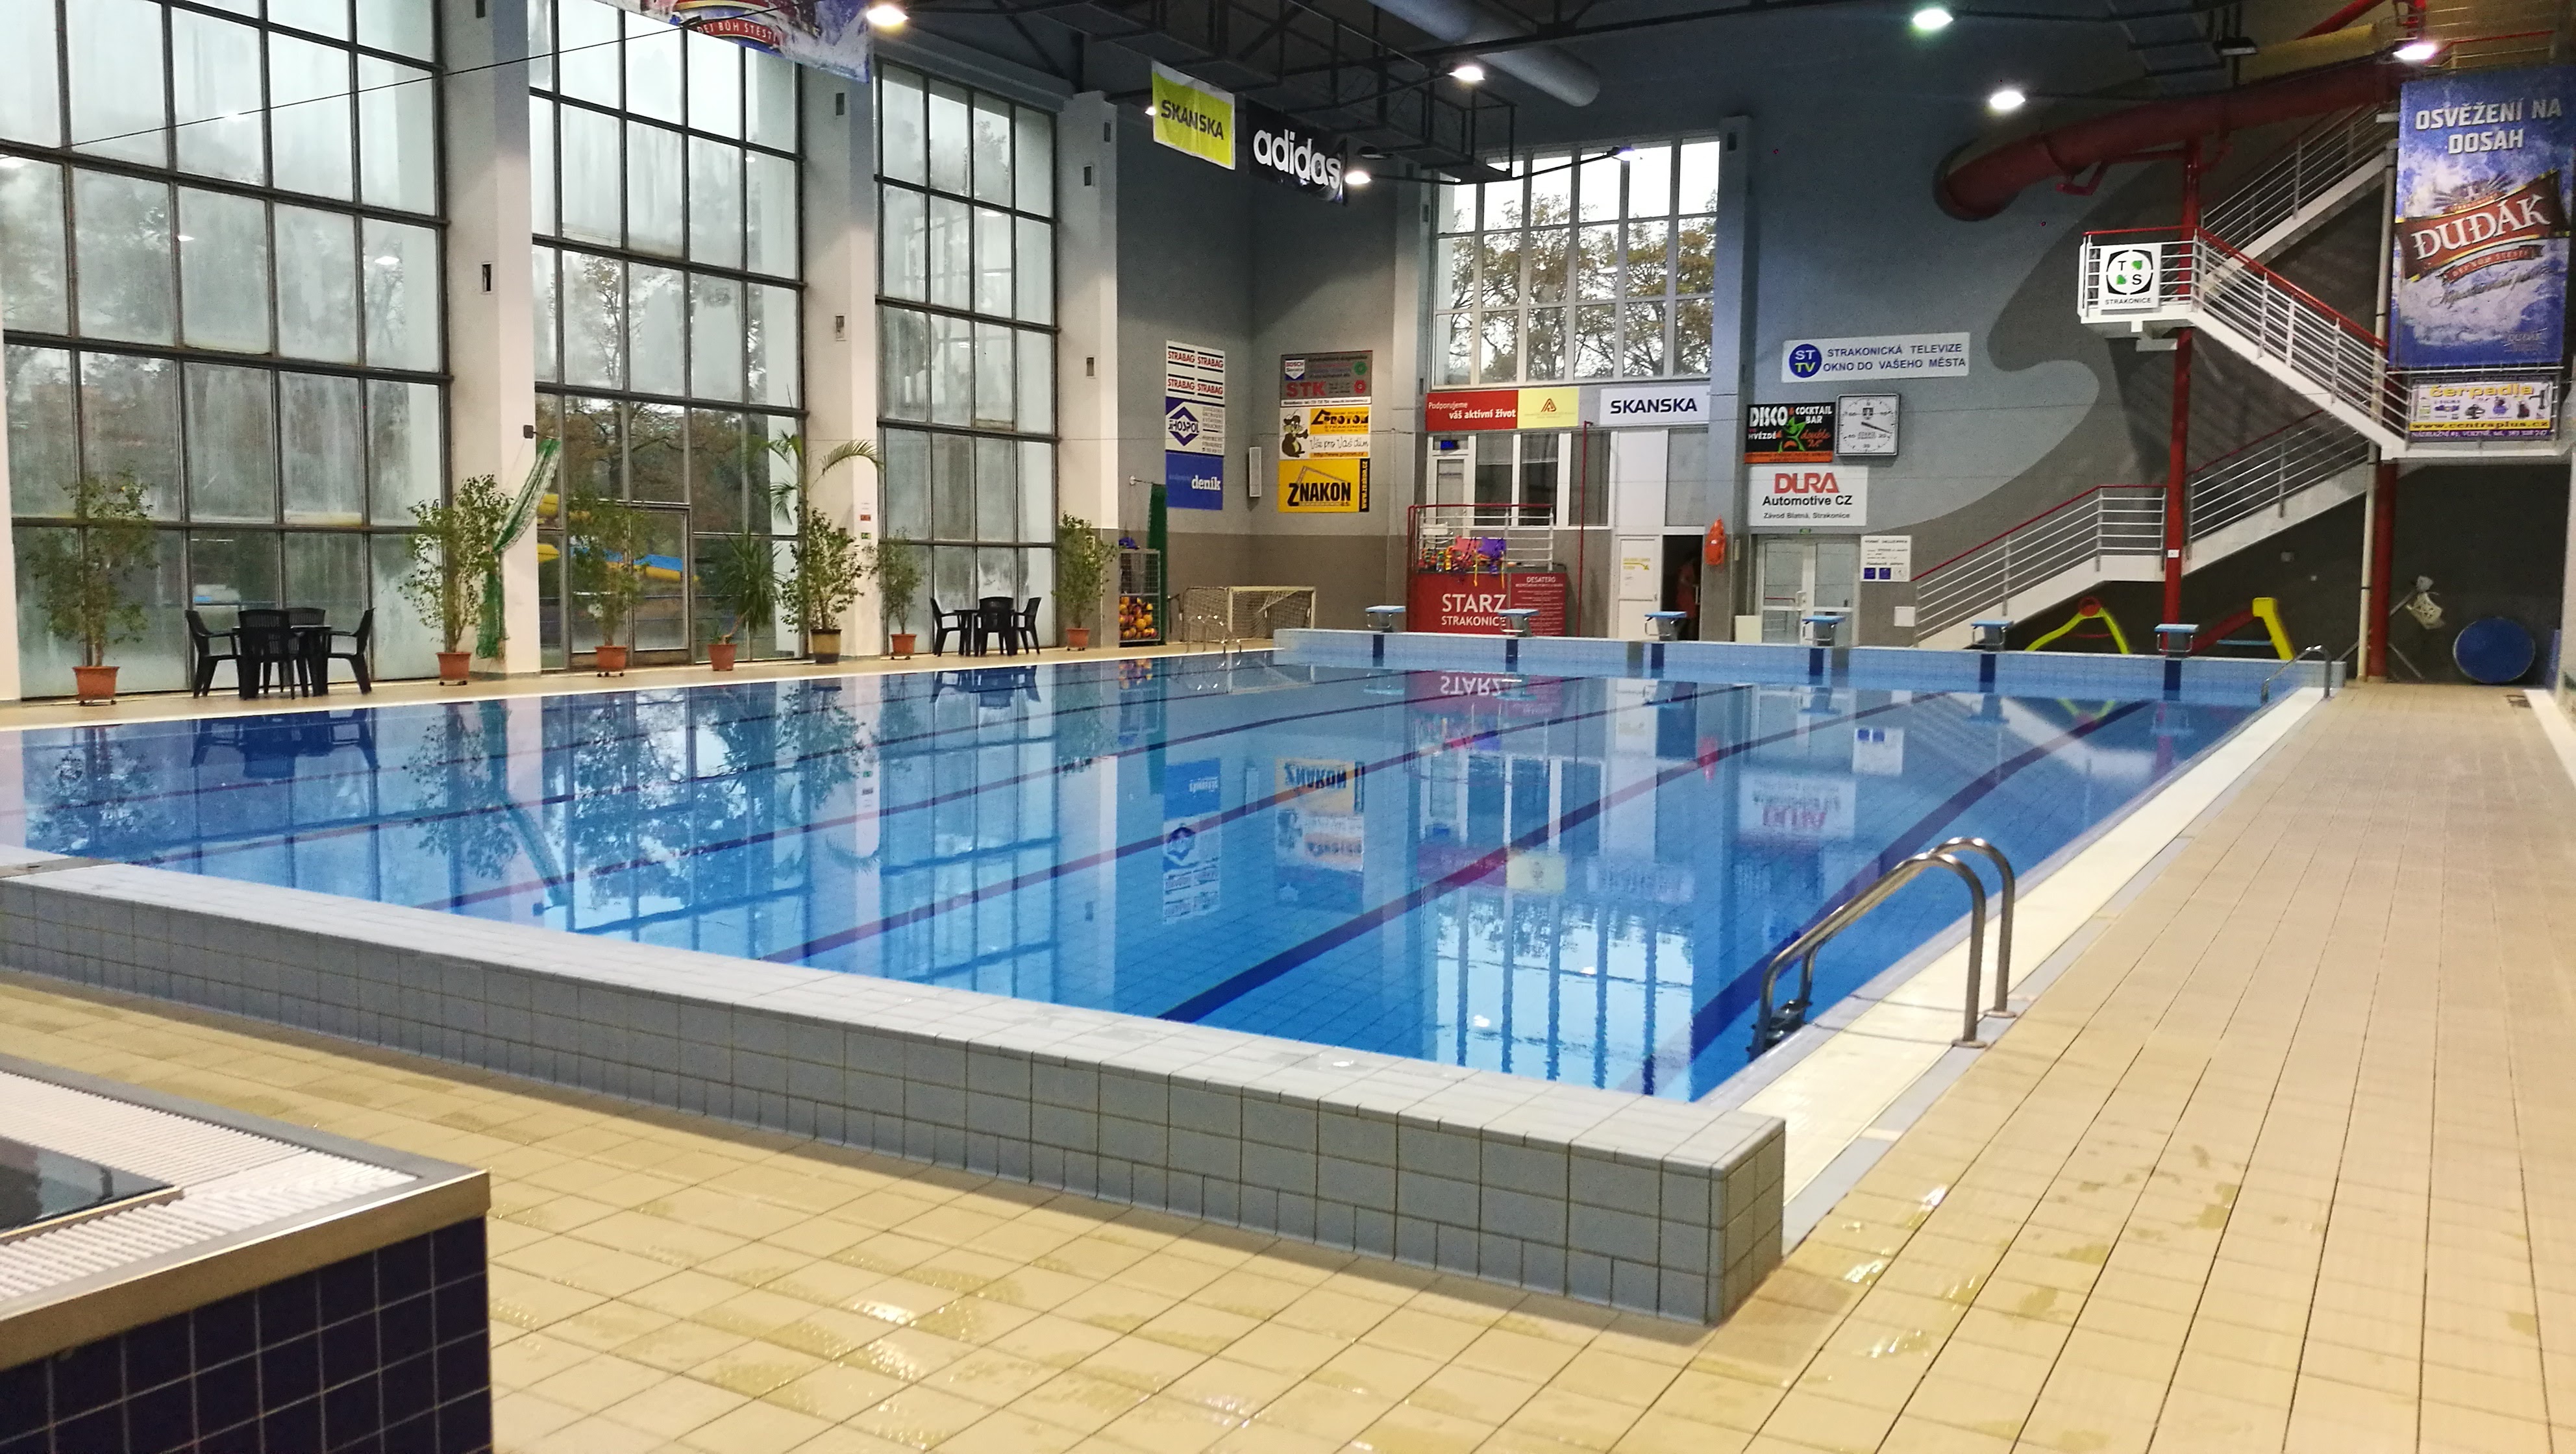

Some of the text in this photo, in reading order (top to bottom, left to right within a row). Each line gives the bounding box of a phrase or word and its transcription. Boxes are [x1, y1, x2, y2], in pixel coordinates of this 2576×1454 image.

[1160, 99, 1224, 140] SKANSKA
[2415, 97, 2563, 130] OSVĚŽENÍ NA
[2448, 129, 2524, 154] DOSAH
[1253, 129, 1342, 189] adidas
[2410, 193, 2552, 260] DUDÁK
[2118, 260, 2127, 271] T
[2132, 274, 2142, 285] S
[1794, 349, 1816, 360] ST
[1827, 343, 1963, 357] STRAKONICKÁ TELEVIZE
[1168, 351, 1224, 368] STRABAG STRABAG
[1795, 362, 1816, 373] TV
[1822, 357, 1966, 372] OKNO DO VAŠEHO MĚSTA
[1168, 378, 1223, 395] STRABAG STRABAG
[1286, 380, 1327, 397] STK
[1428, 401, 1468, 410] Podporujeme
[1449, 410, 1463, 419] váš
[1464, 410, 1493, 419] aktivní
[1495, 408, 1517, 418] život
[1610, 398, 1698, 414] SKANSKA
[1749, 406, 1789, 427] DISCO
[1795, 405, 1833, 415] COCKTAIL
[1804, 415, 1824, 425] BAR
[2412, 421, 2549, 429] www.centraplus.cz
[1191, 474, 1221, 491] deník
[1773, 472, 1840, 494] DURA
[1287, 482, 1351, 506] ZNAKON
[1762, 495, 1852, 506] Automotive CZ
[1442, 593, 1507, 613] STARZ
[1441, 615, 1507, 626] STRAKONICE
